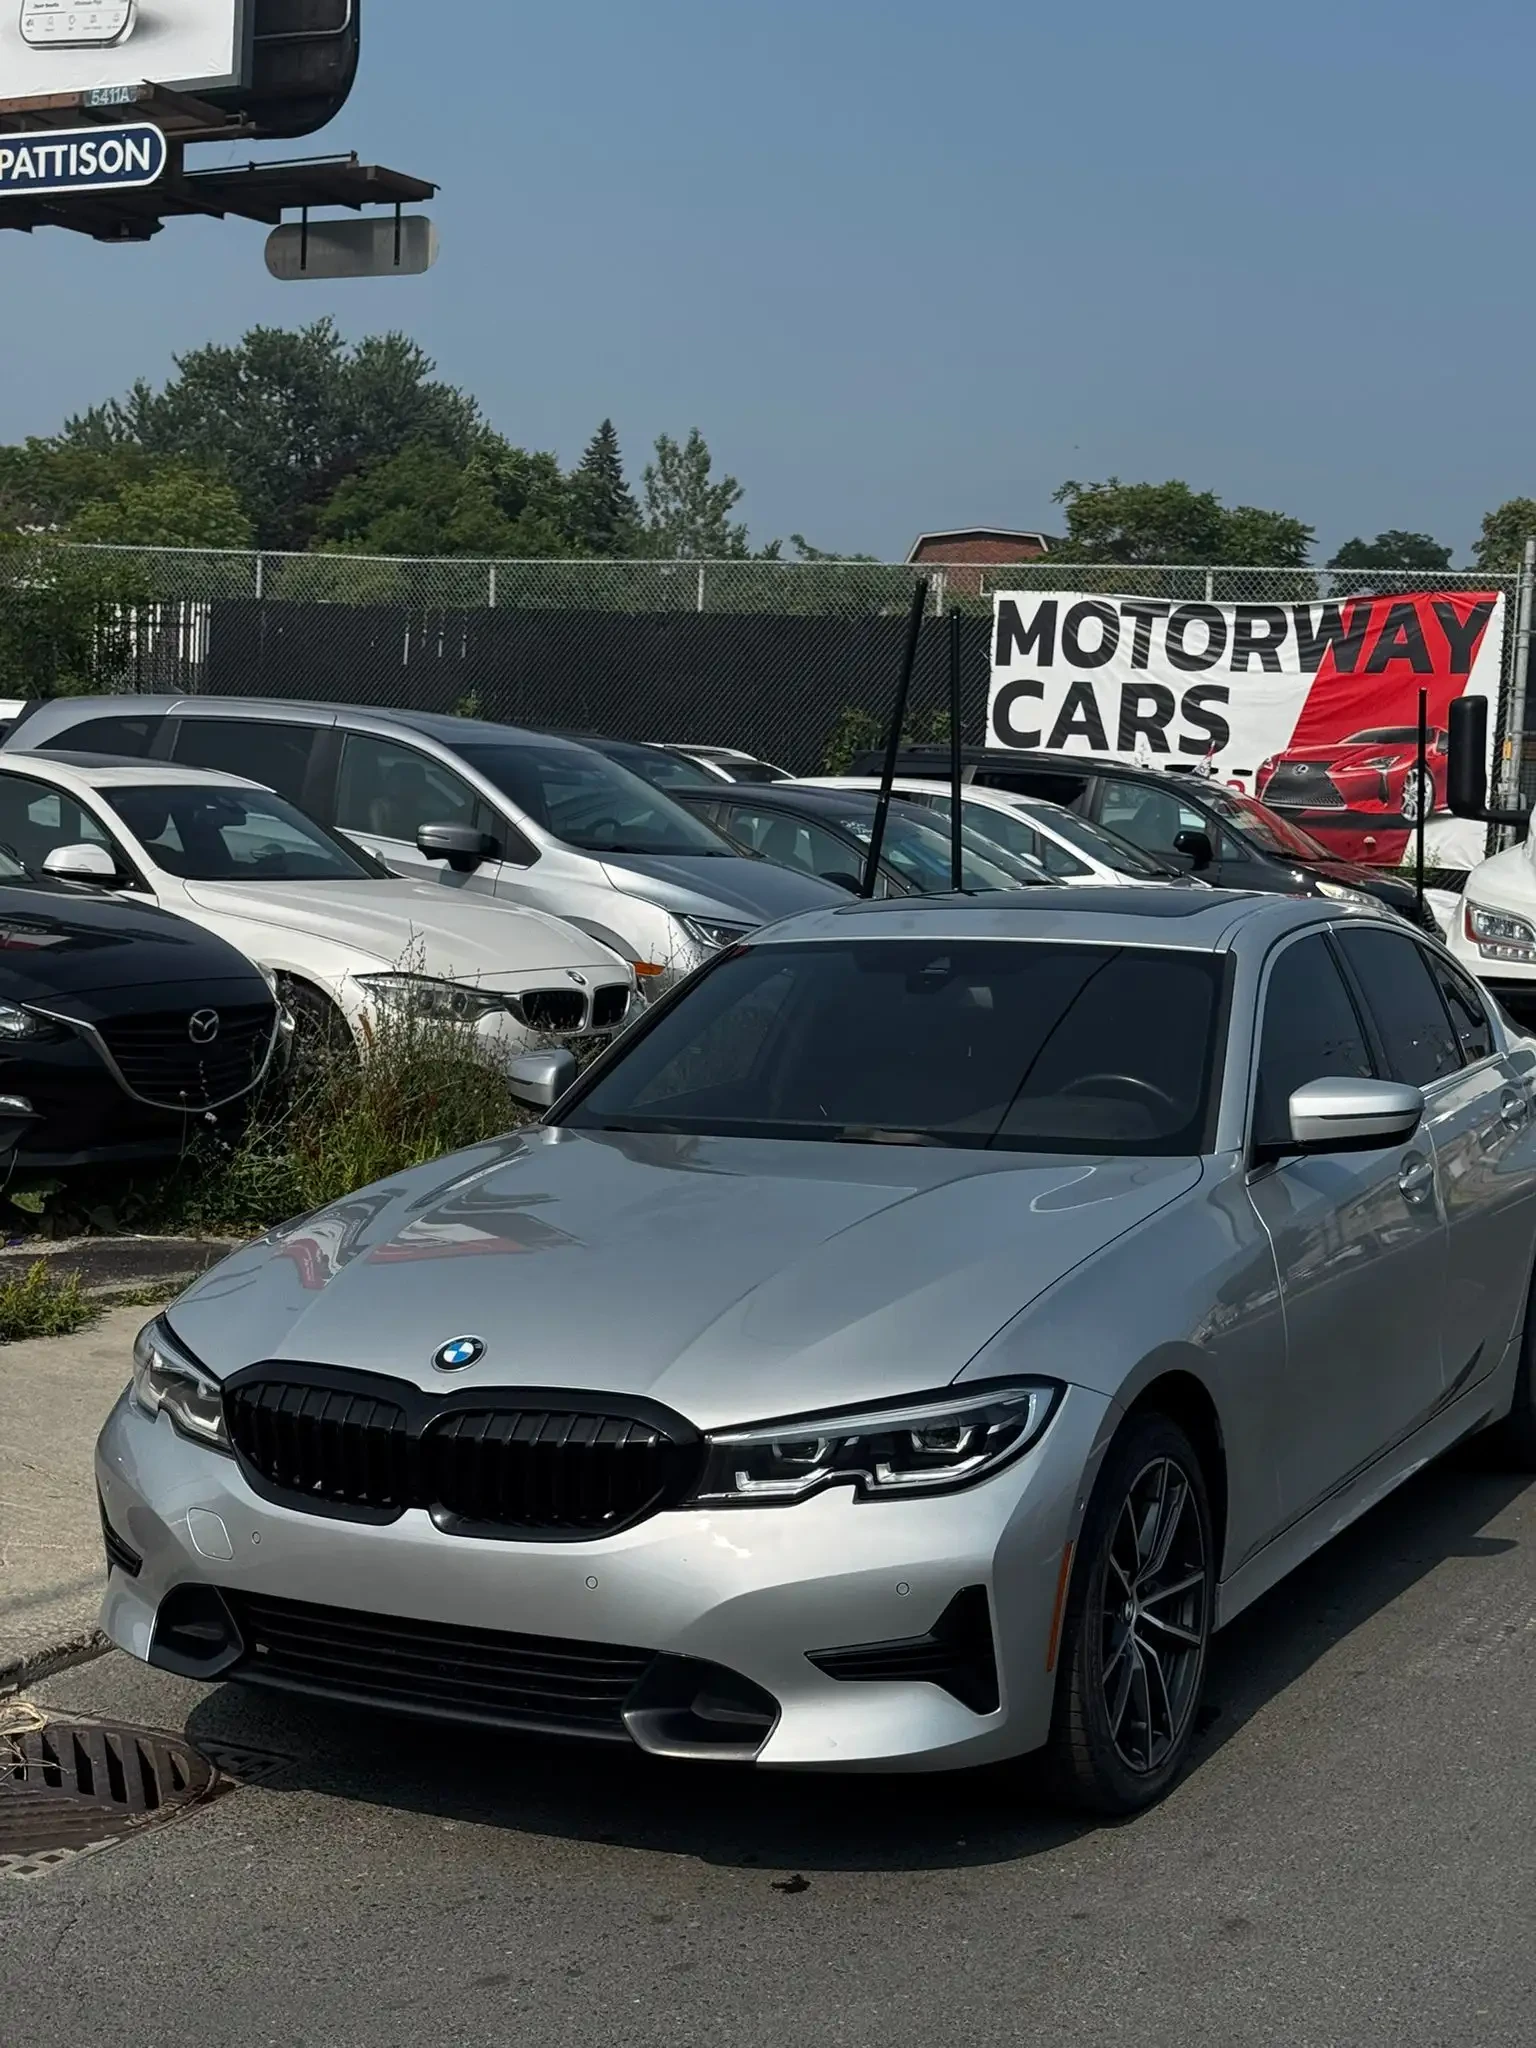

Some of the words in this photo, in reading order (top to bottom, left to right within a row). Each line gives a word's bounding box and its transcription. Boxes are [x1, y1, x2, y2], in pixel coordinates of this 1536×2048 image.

[91, 87, 129, 105] 5411A
[0, 138, 150, 180] PATTISON
[995, 599, 1496, 674] MOTORWAY
[992, 679, 1230, 755] CARS
